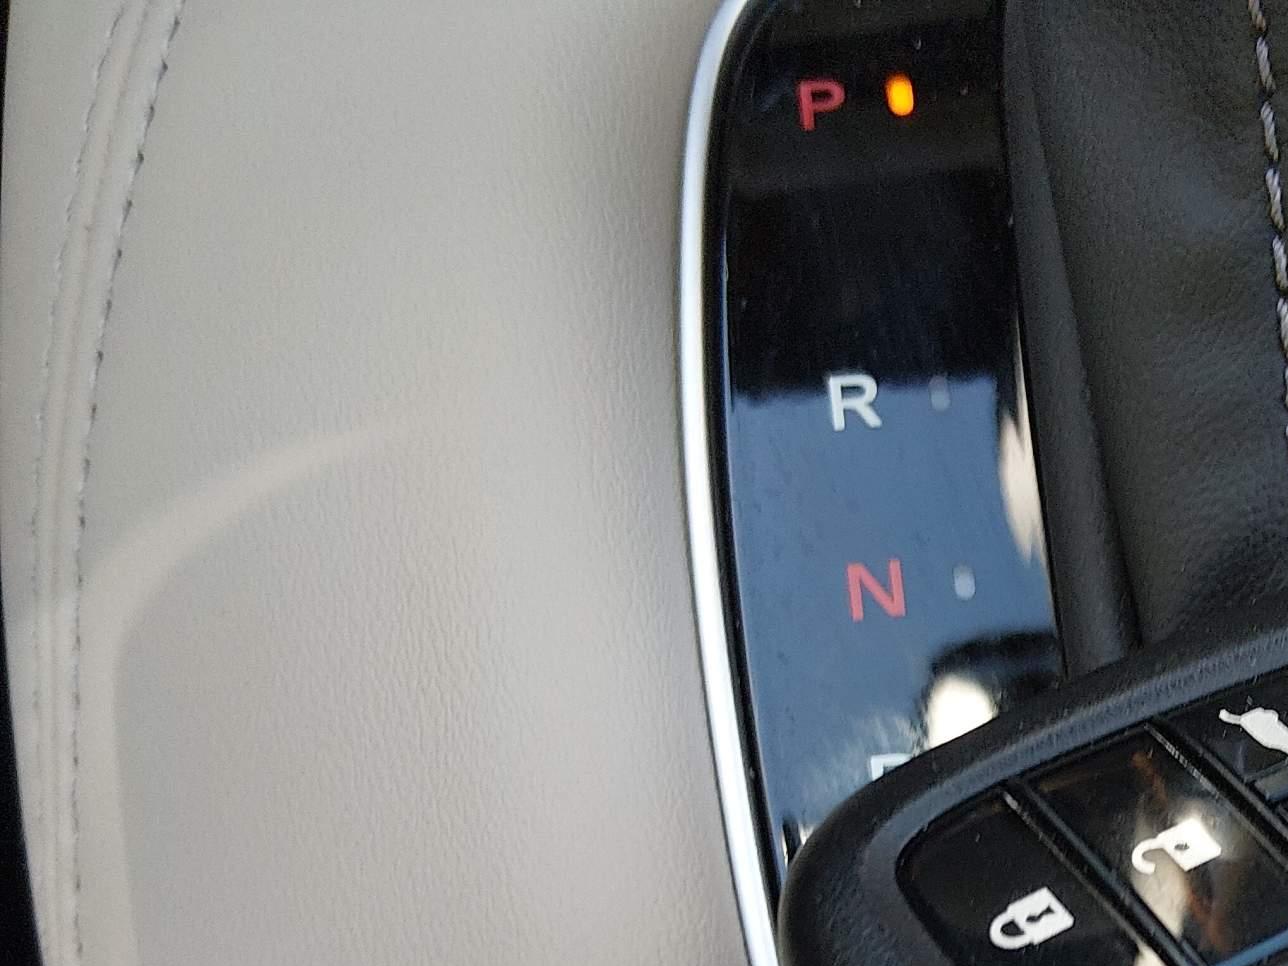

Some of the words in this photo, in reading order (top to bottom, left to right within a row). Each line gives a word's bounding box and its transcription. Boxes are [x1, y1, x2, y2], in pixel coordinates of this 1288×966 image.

[797, 77, 846, 131] P
[828, 373, 882, 432] R
[846, 558, 906, 622] N
